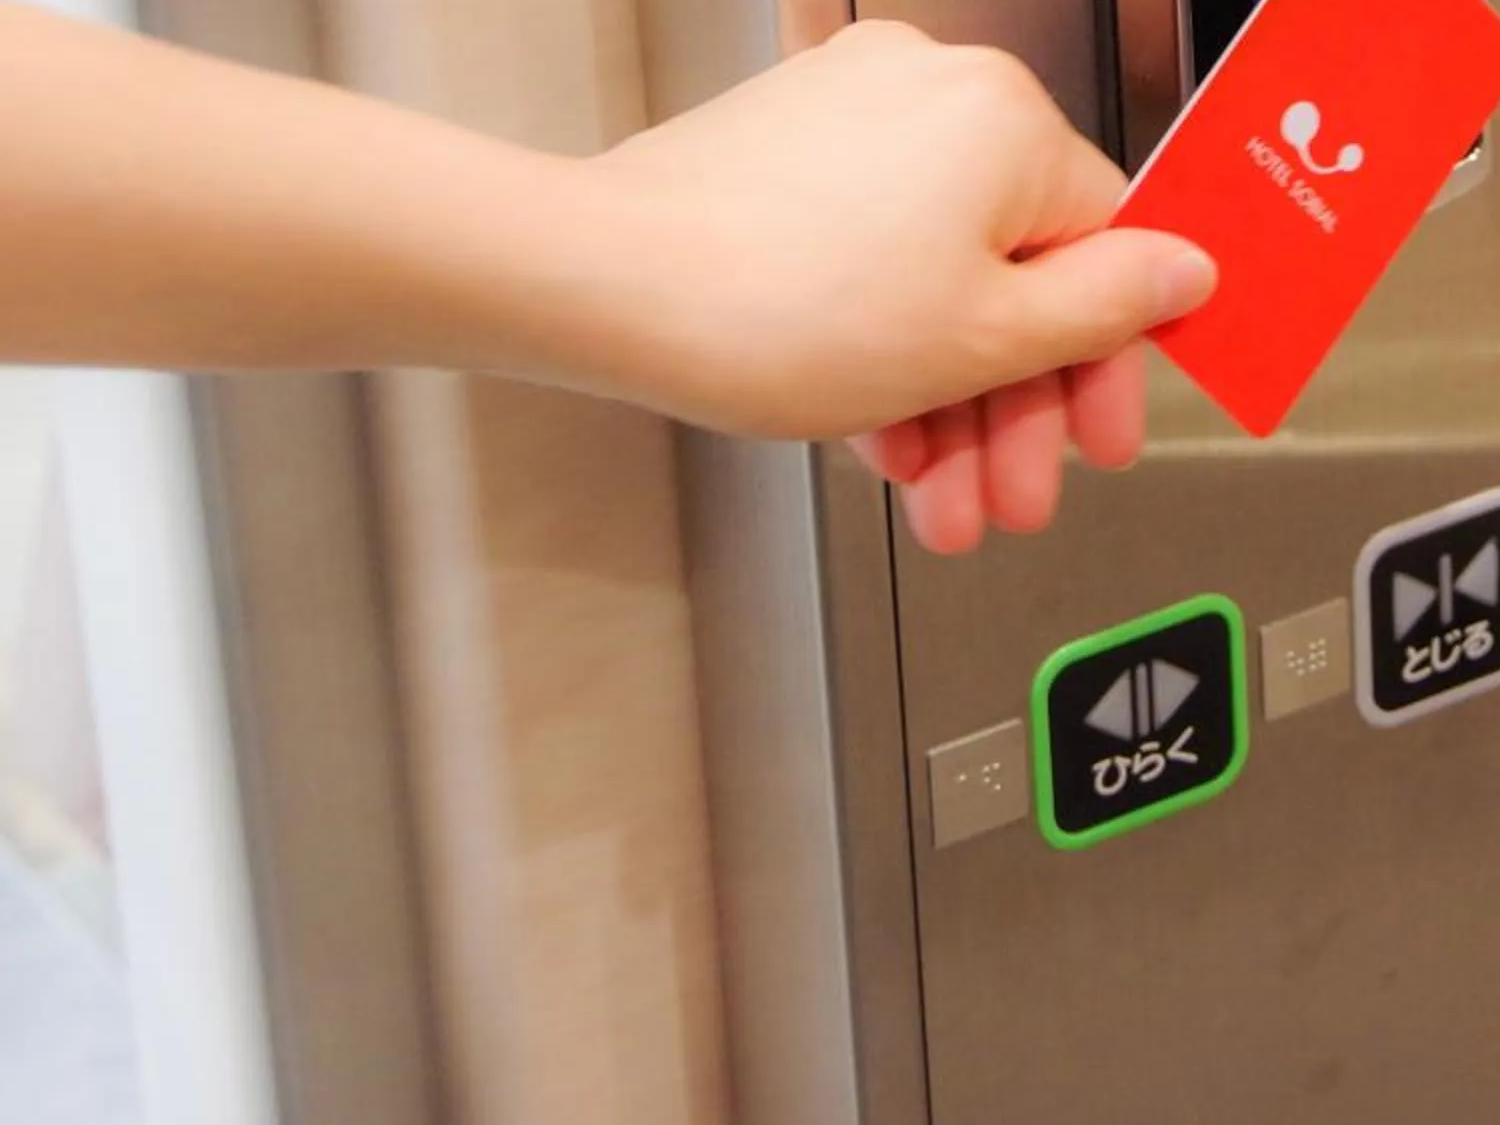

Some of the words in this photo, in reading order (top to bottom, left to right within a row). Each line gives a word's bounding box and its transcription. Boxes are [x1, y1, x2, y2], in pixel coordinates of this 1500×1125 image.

[1244, 135, 1294, 188] HOTEL
[1401, 619, 1495, 685] とじる
[1091, 726, 1199, 797] ひらく
